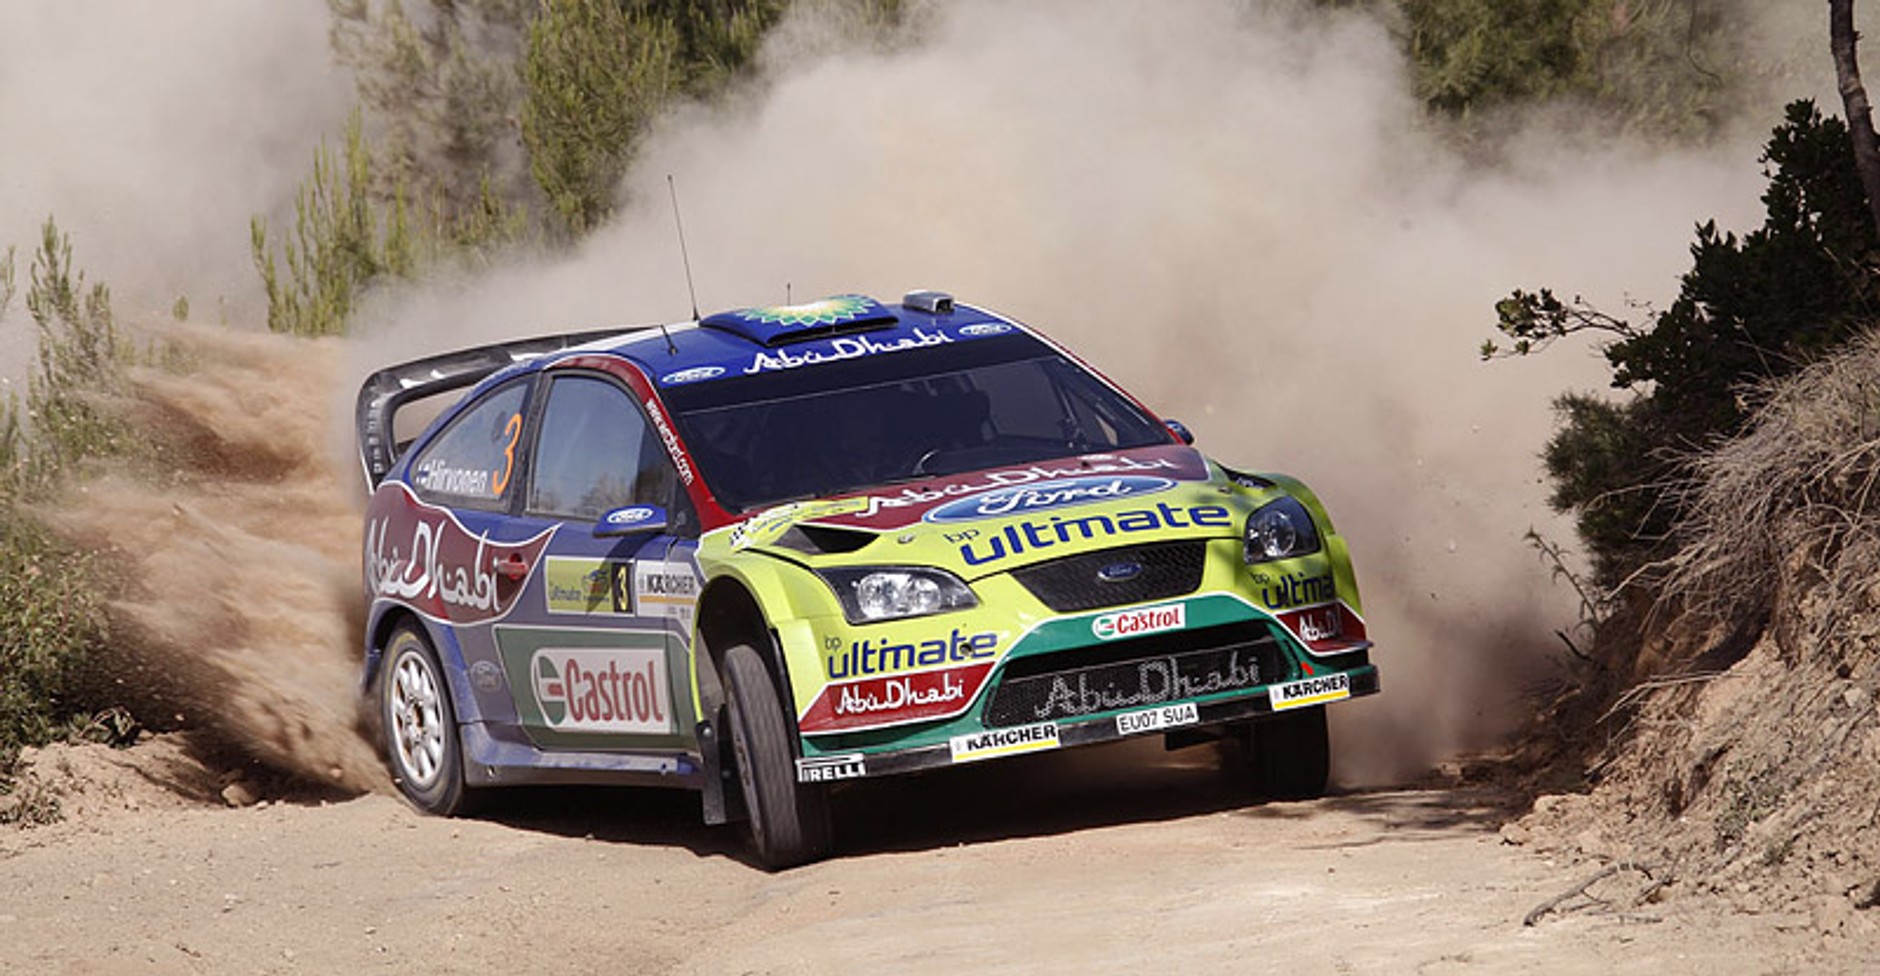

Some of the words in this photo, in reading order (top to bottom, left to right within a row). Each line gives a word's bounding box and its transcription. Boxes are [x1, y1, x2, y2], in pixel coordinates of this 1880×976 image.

[492, 413, 522, 495] 3
[425, 459, 487, 494] Hirvonen
[977, 479, 1133, 515] Ford
[944, 528, 979, 544] bp
[960, 503, 1232, 566] ultimate
[617, 565, 628, 612] 3
[1117, 607, 1180, 634] Castrol
[828, 629, 998, 679] ultimate
[565, 658, 664, 723] Castrol
[1119, 710, 1158, 732] EU07
[1163, 705, 1195, 724] SUA
